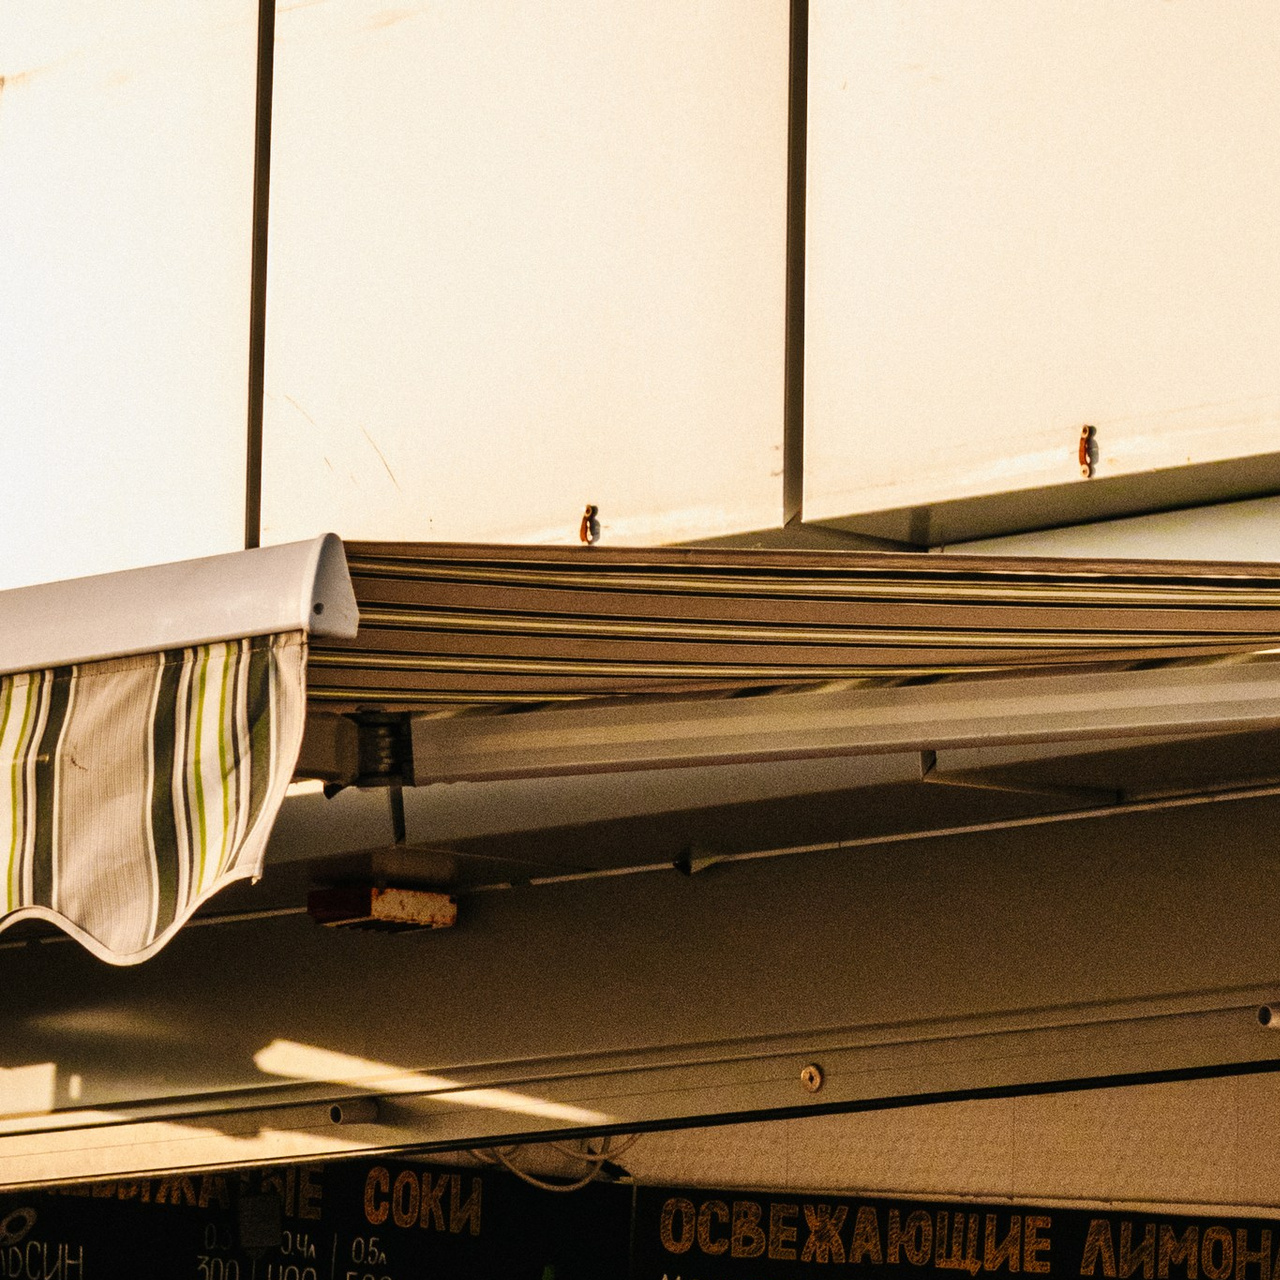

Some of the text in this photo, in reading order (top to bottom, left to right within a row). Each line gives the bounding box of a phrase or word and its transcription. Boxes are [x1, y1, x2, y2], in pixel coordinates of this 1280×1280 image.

[363, 1165, 483, 1236] СОКИ
[351, 1236, 387, 1265] 0.5л
[659, 1197, 1053, 1278] ОСВЕЖАЮЩИЕ
